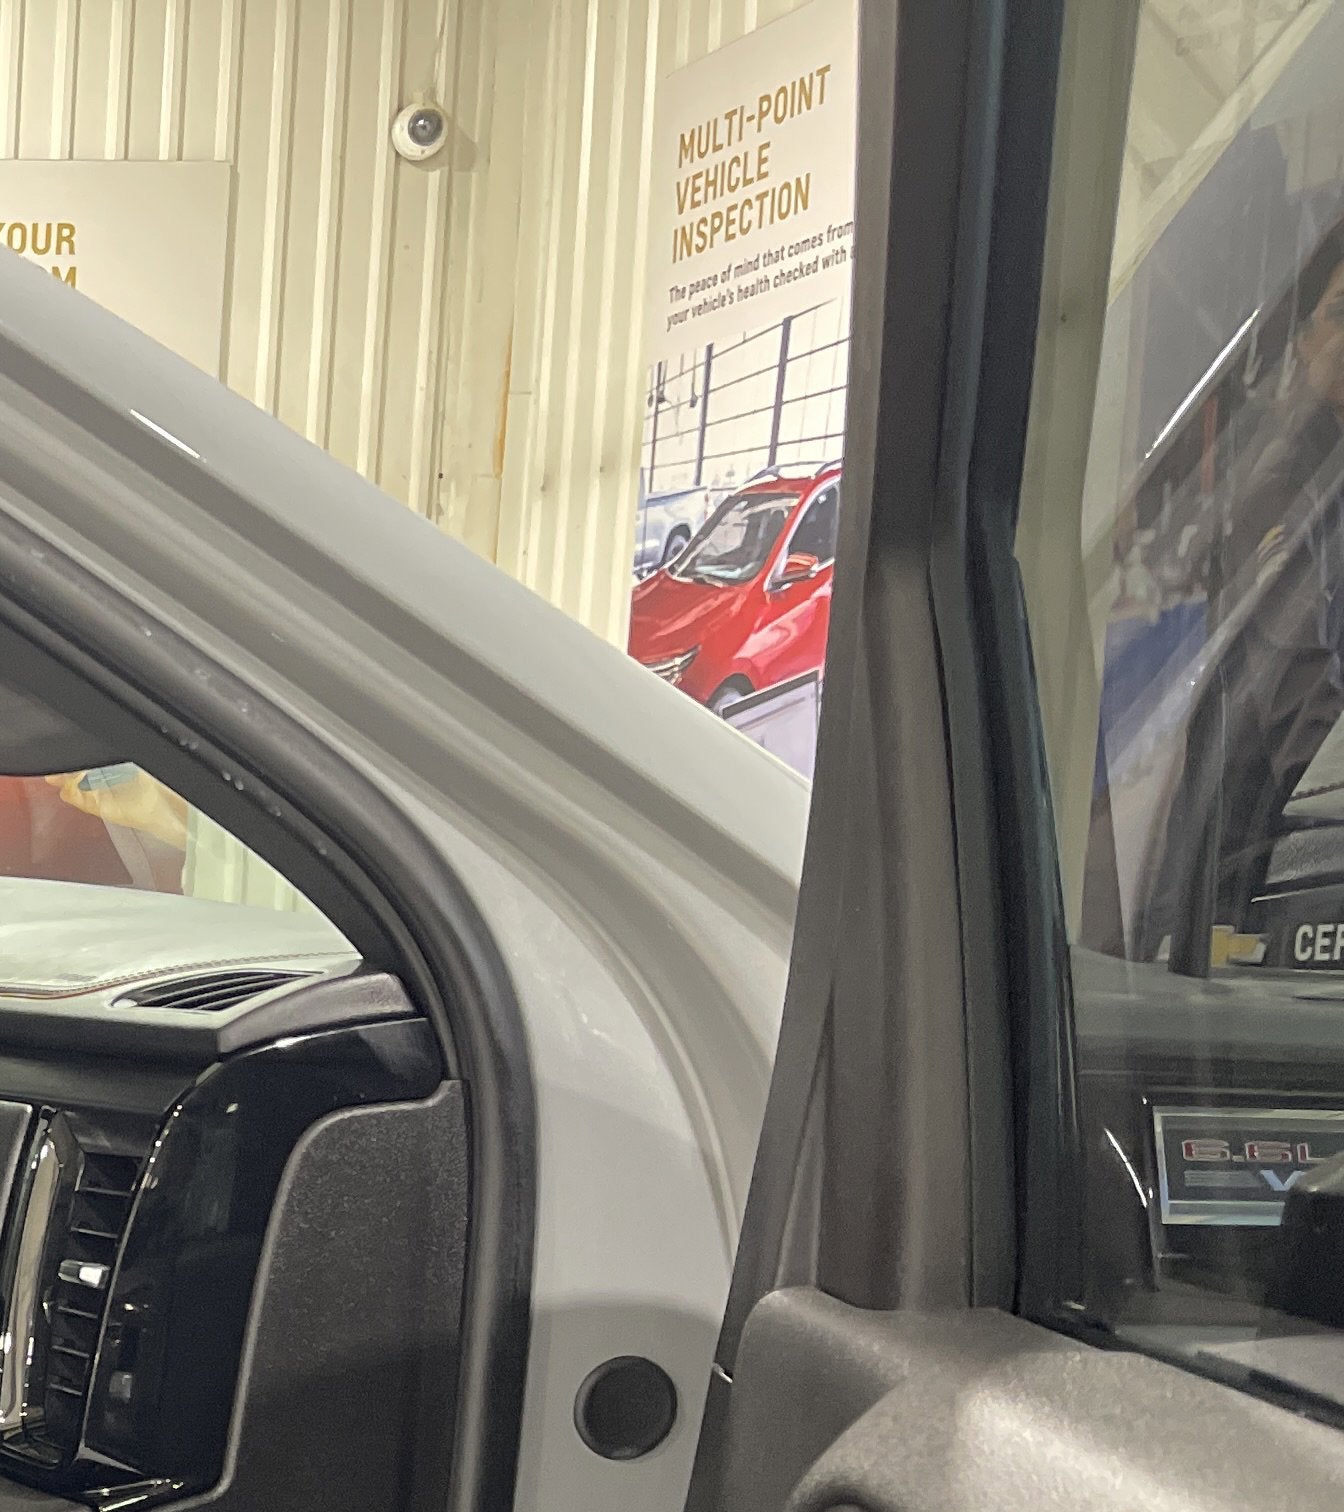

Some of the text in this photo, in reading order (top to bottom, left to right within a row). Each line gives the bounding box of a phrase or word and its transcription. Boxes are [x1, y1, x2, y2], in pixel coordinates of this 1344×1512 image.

[678, 64, 831, 169] MULTI-POINT
[672, 173, 811, 264] INSPECTION
[676, 141, 771, 215] VEHICLE
[666, 309, 690, 333] your
[691, 289, 735, 319] vehicle's
[736, 277, 771, 302] health
[772, 255, 820, 289] checked
[821, 245, 848, 271] with
[669, 285, 687, 304] The
[688, 273, 719, 300] peace
[720, 263, 732, 284] of
[733, 253, 760, 280] mind
[762, 245, 786, 268] that
[787, 232, 824, 258] comes
[826, 221, 854, 244] from
